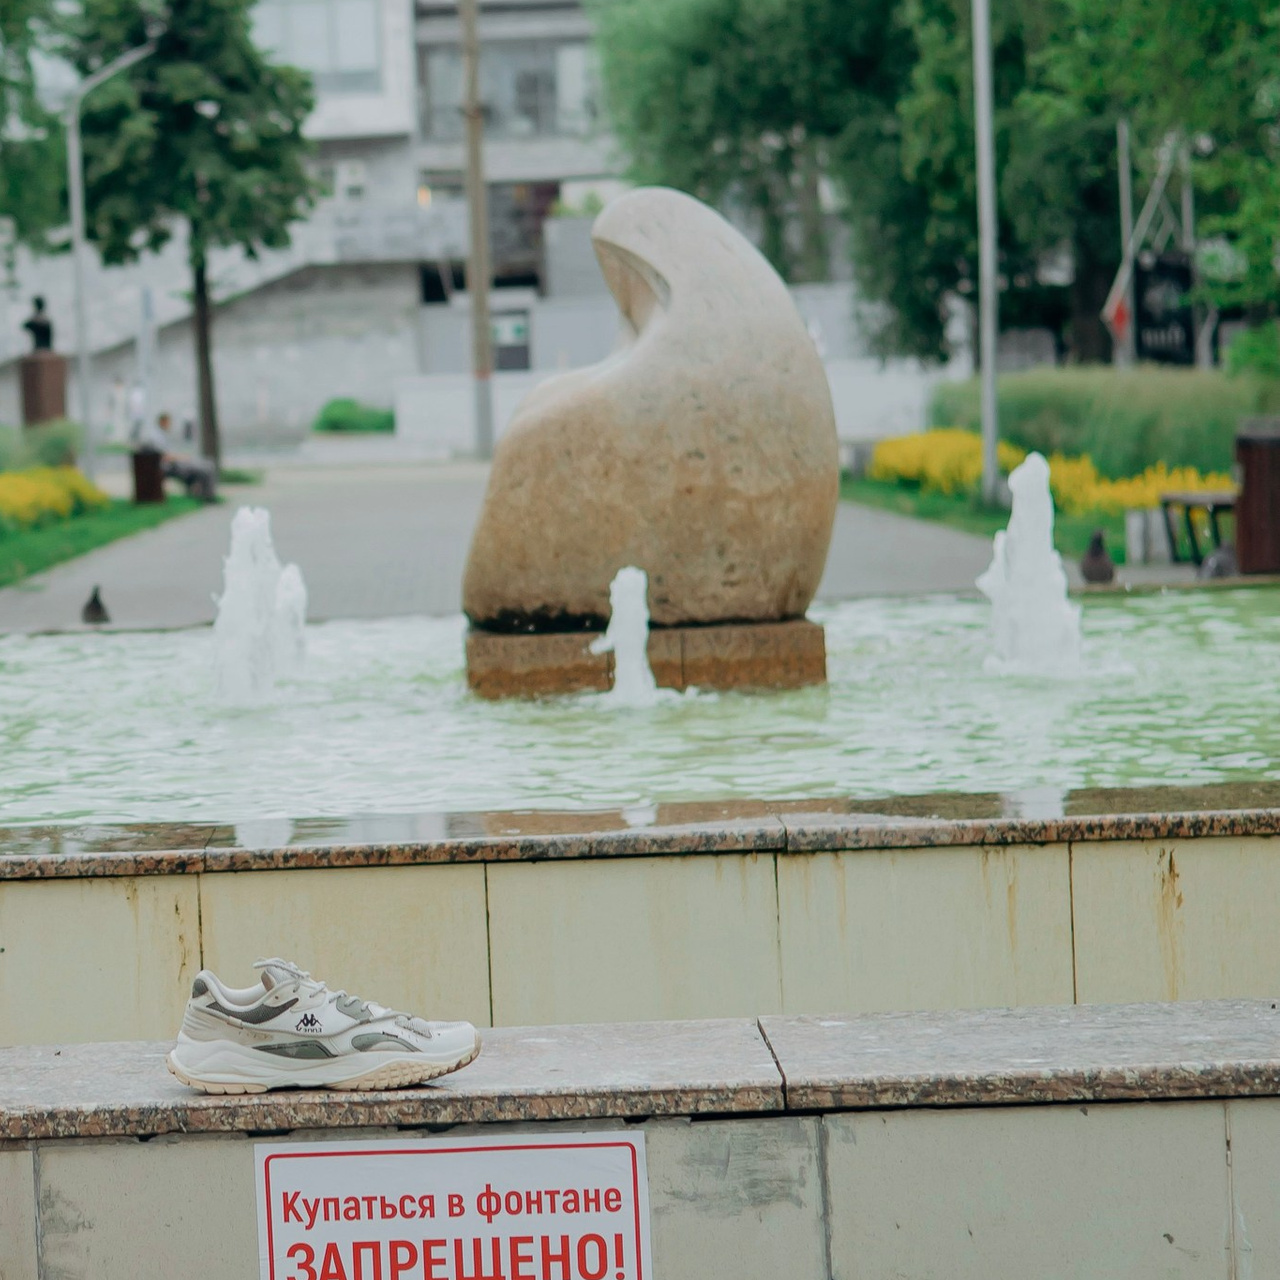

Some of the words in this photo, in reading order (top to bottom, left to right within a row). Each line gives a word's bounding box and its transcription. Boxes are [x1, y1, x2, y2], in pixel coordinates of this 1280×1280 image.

[282, 1190, 436, 1231] Купаться
[447, 1193, 466, 1218] в
[476, 1183, 622, 1224] фонтане
